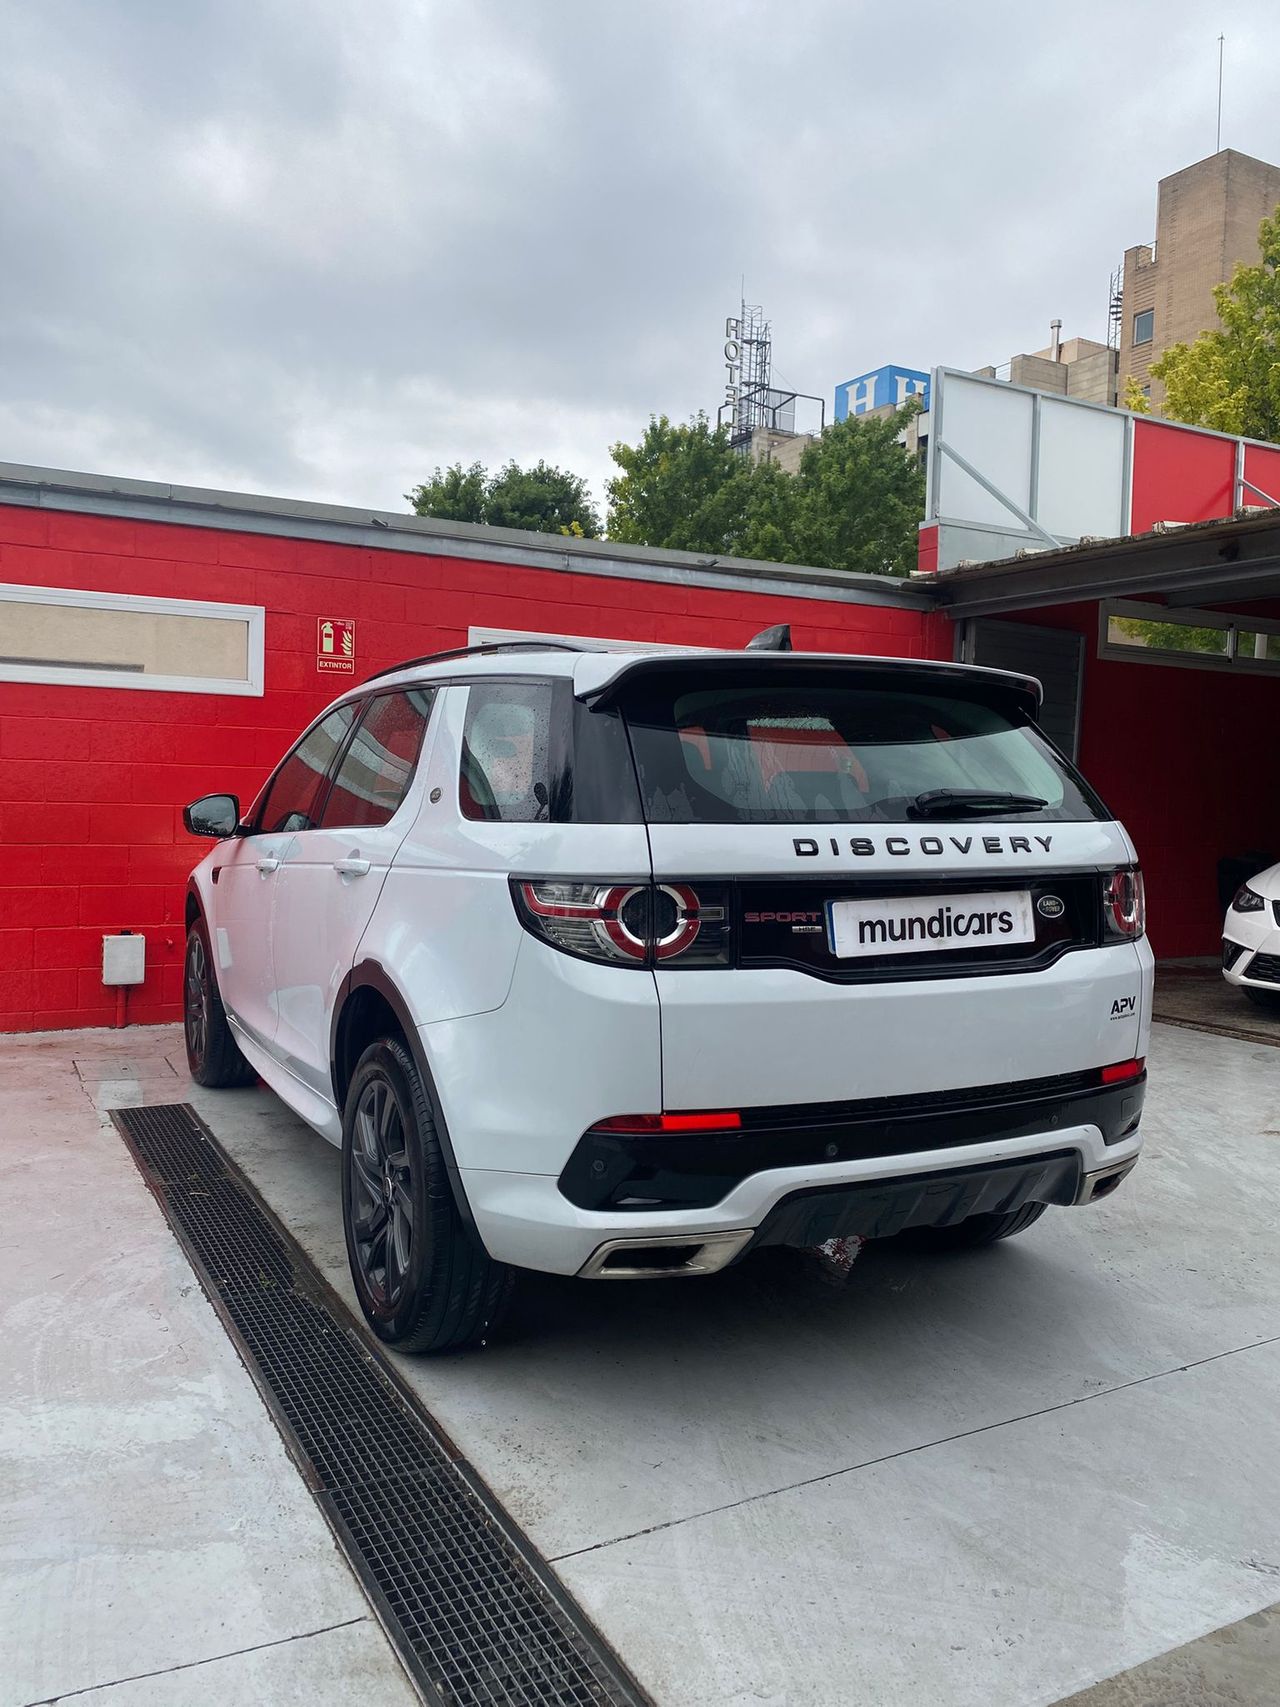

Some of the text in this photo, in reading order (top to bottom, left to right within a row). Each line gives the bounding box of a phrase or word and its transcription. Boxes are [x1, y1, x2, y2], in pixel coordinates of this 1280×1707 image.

[846, 376, 878, 416] H
[319, 661, 352, 669] EXTINTOR
[792, 836, 1053, 857] DISCOVERY
[744, 912, 822, 923] SPORT
[858, 907, 1014, 944] mundicars
[1110, 995, 1136, 1015] APV
